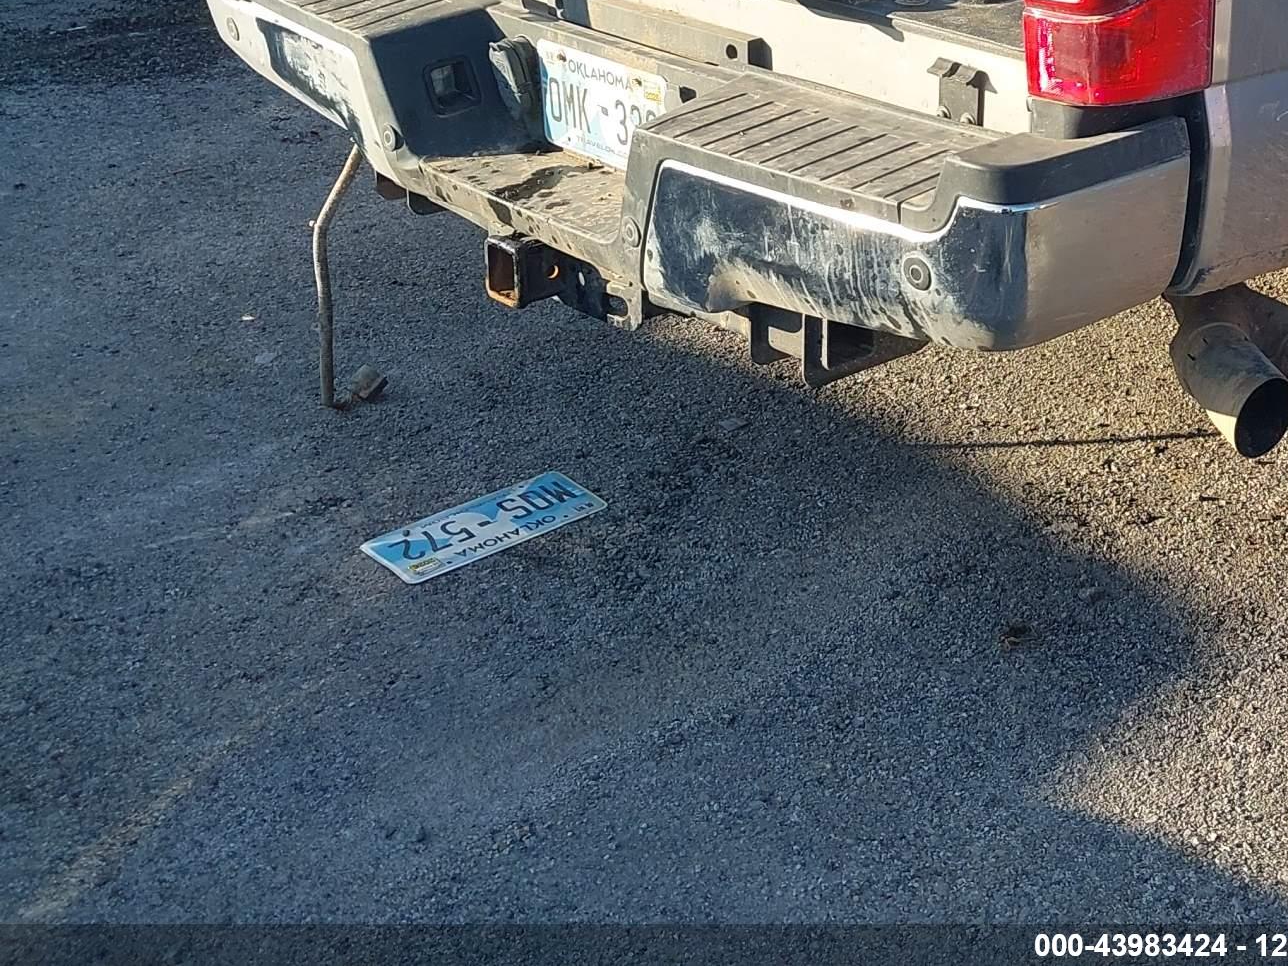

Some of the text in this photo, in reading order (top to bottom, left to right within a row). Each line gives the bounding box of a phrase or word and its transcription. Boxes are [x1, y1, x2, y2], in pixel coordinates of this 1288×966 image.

[567, 58, 634, 92] OKLAHOMA
[388, 520, 478, 561] 572
[453, 514, 557, 558] OKLAHOMA
